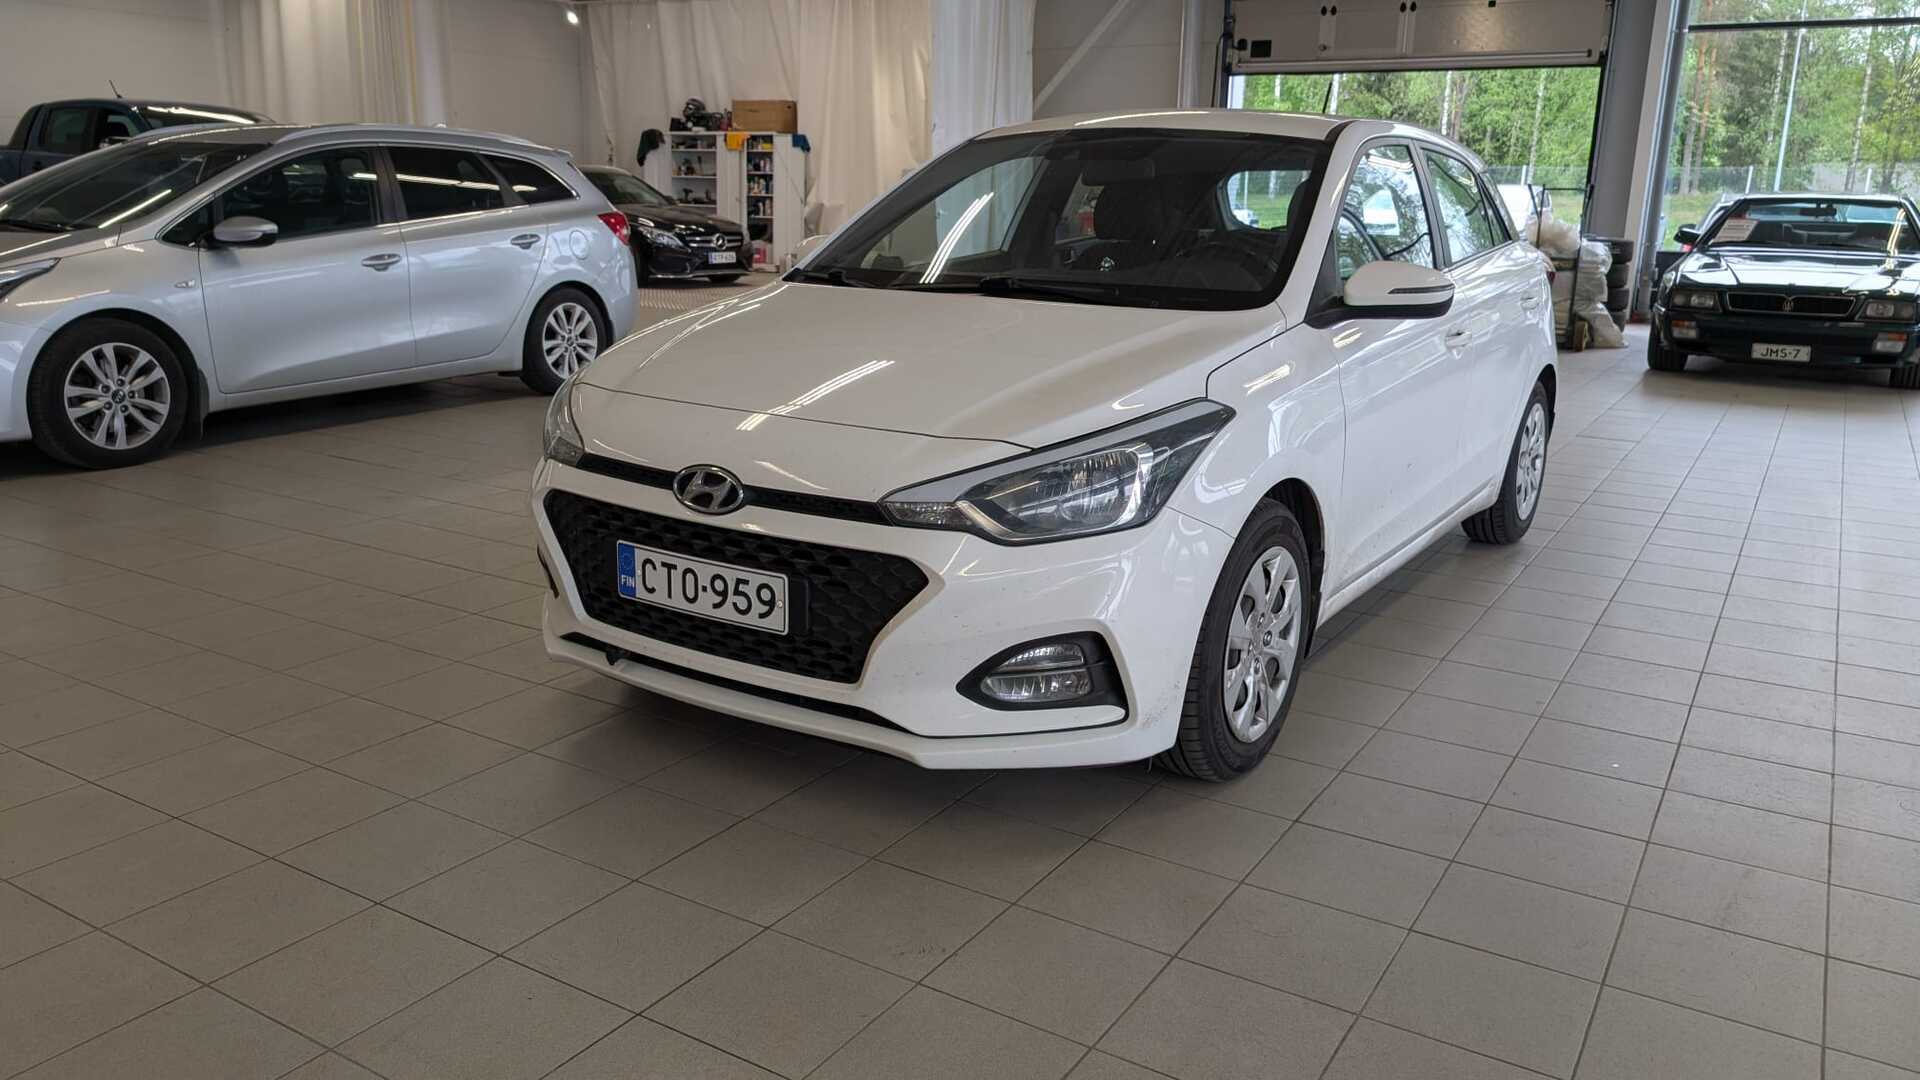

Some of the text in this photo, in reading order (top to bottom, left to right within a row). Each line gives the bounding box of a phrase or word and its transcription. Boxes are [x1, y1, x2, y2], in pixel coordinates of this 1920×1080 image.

[1760, 347, 1801, 359] JMS-7
[621, 575, 635, 588] FIN
[641, 558, 776, 619] CTO-959
